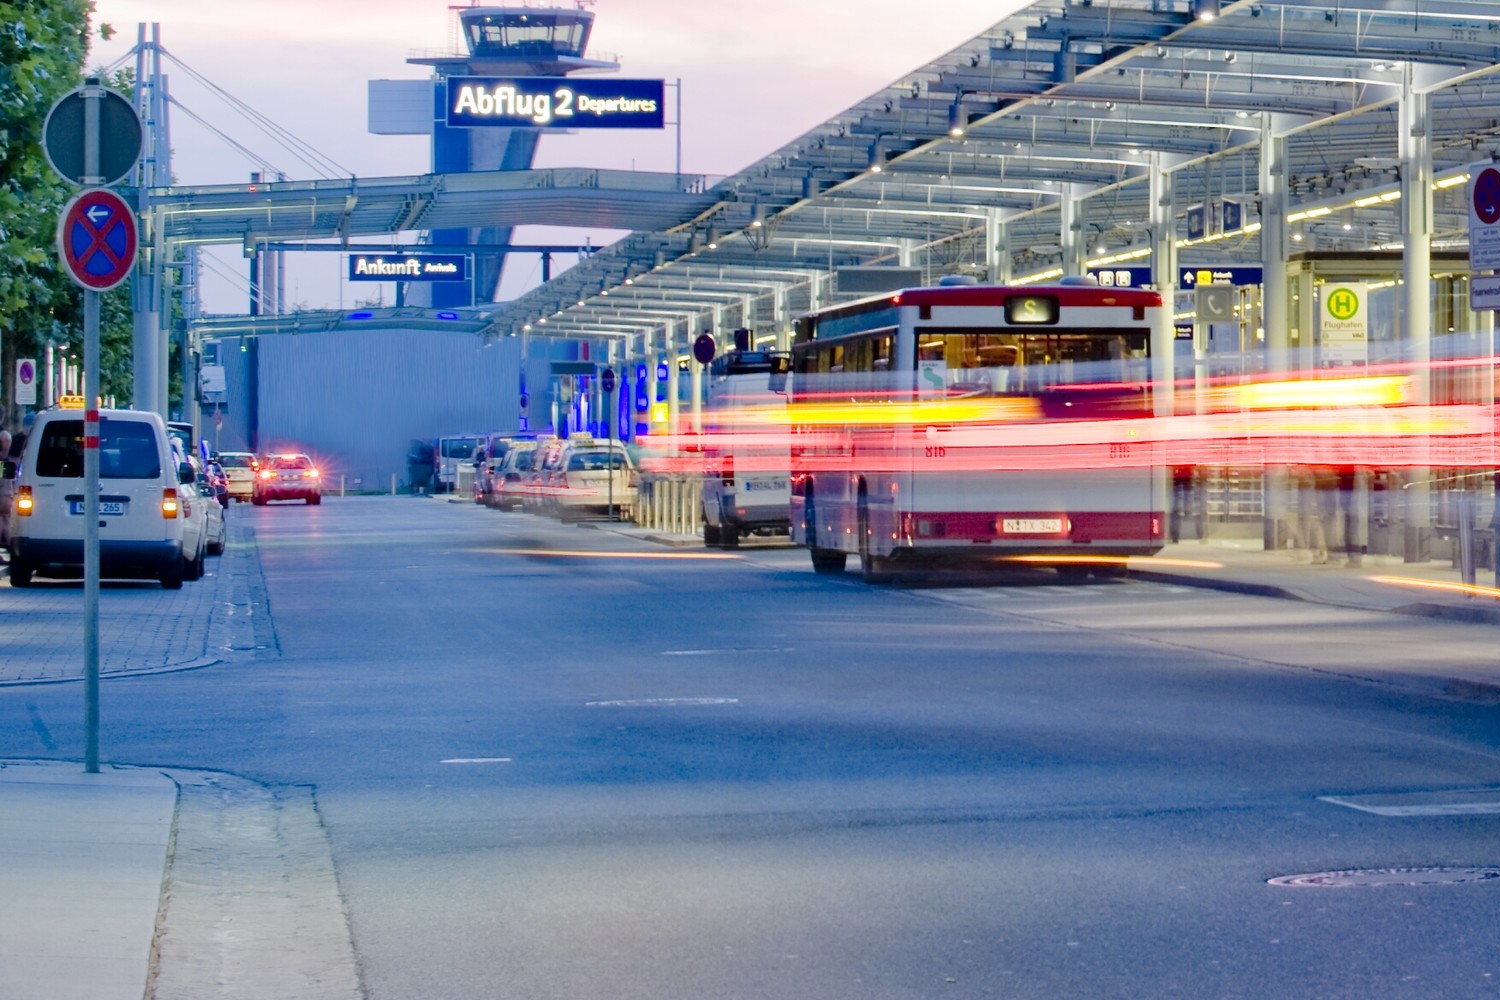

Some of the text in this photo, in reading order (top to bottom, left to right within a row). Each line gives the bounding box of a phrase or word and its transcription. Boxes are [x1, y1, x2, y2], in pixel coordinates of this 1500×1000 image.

[455, 86, 656, 123] Abflug 2 Departures
[355, 258, 457, 275] Ankunft Arrivals
[1024, 299, 1036, 318] S
[1335, 295, 1351, 313] H
[1324, 321, 1363, 330] Flughafen
[103, 503, 120, 512] 265
